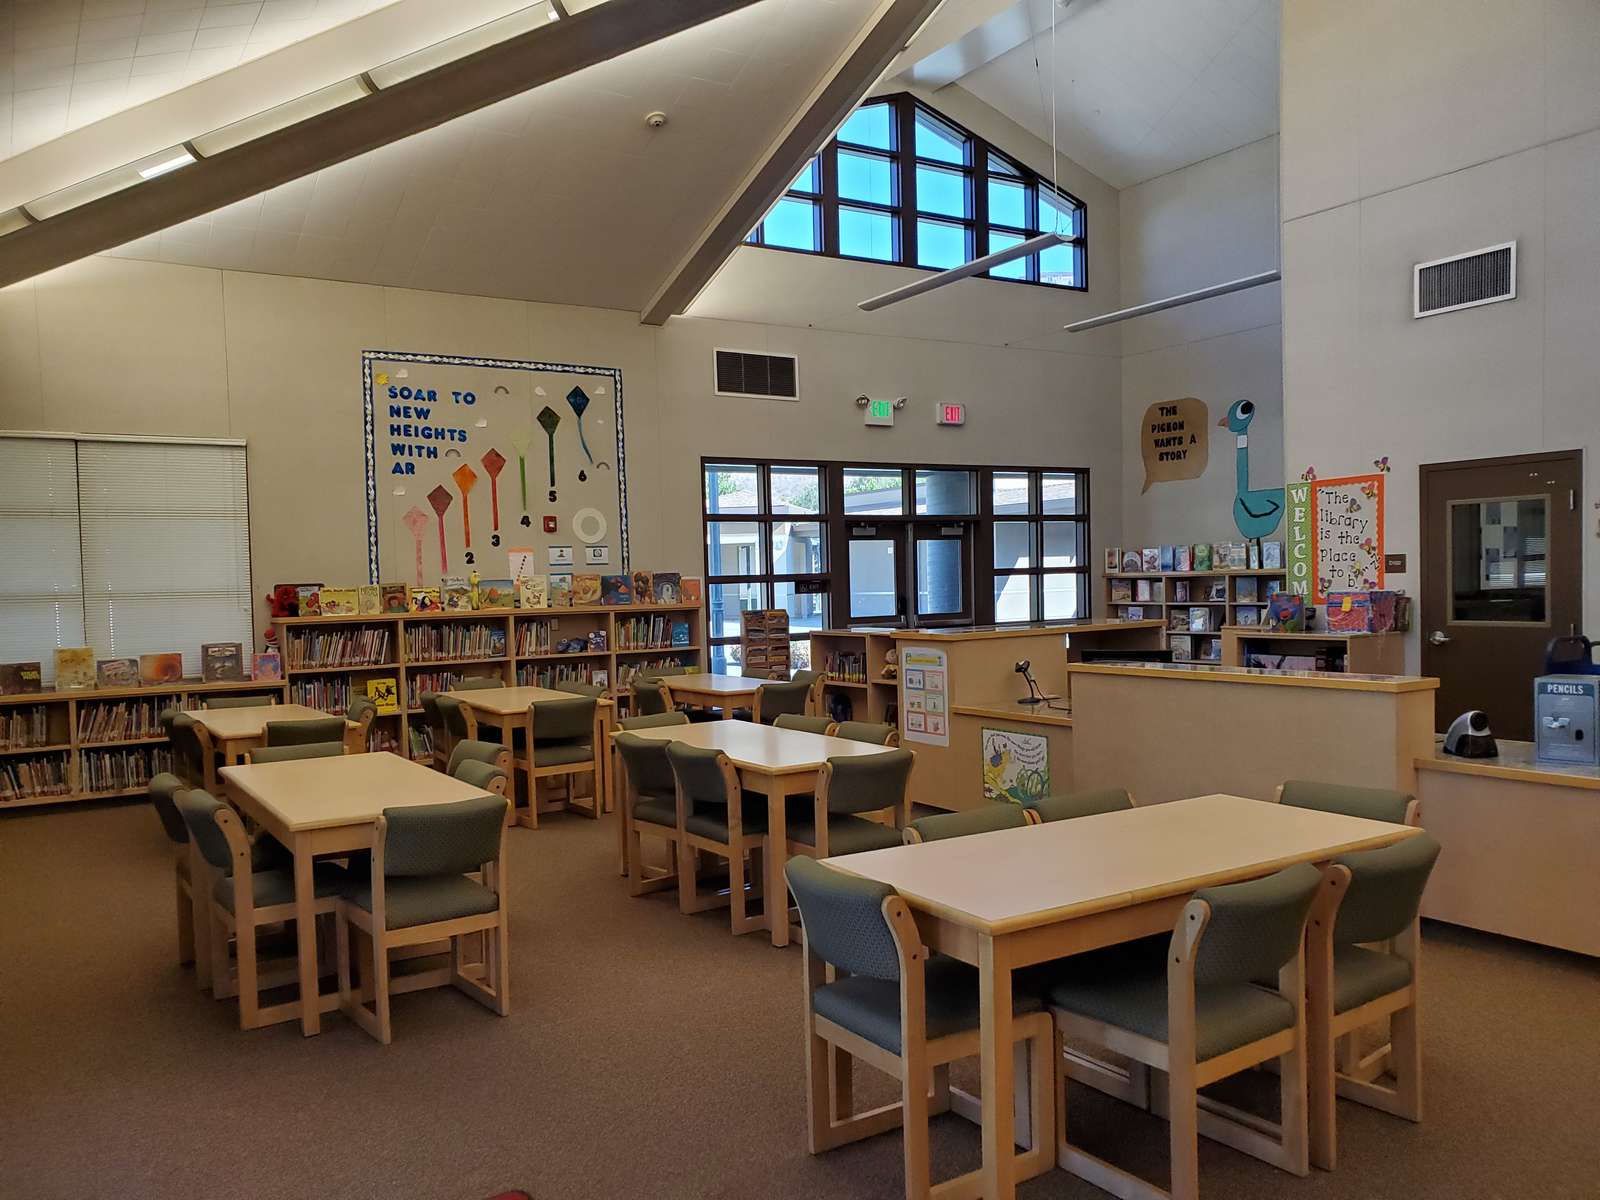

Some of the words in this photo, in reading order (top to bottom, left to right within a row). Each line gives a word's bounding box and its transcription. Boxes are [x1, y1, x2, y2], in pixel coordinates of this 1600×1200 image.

[388, 386, 437, 402] SOAR
[452, 391, 476, 405] TO
[389, 404, 431, 420] NEW
[871, 400, 890, 416] EXIT
[945, 406, 960, 421] EXIT
[1158, 405, 1177, 416] THE
[390, 424, 467, 442] HEIGHTS
[1154, 435, 1184, 448] WANTS
[1189, 433, 1197, 444] A
[391, 443, 438, 459] WITH
[1158, 449, 1188, 461] STORY
[392, 462, 416, 475] AR
[578, 470, 587, 482] 6
[548, 490, 557, 502] 5
[520, 516, 531, 527] 4
[1320, 509, 1368, 534] library
[491, 534, 500, 547] 3
[1291, 487, 1309, 596] WELCOM
[1320, 528, 1331, 540] is
[1338, 531, 1360, 544] the
[465, 552, 475, 564] 2
[1329, 565, 1344, 578] to
[1547, 684, 1584, 694] PENCILS
